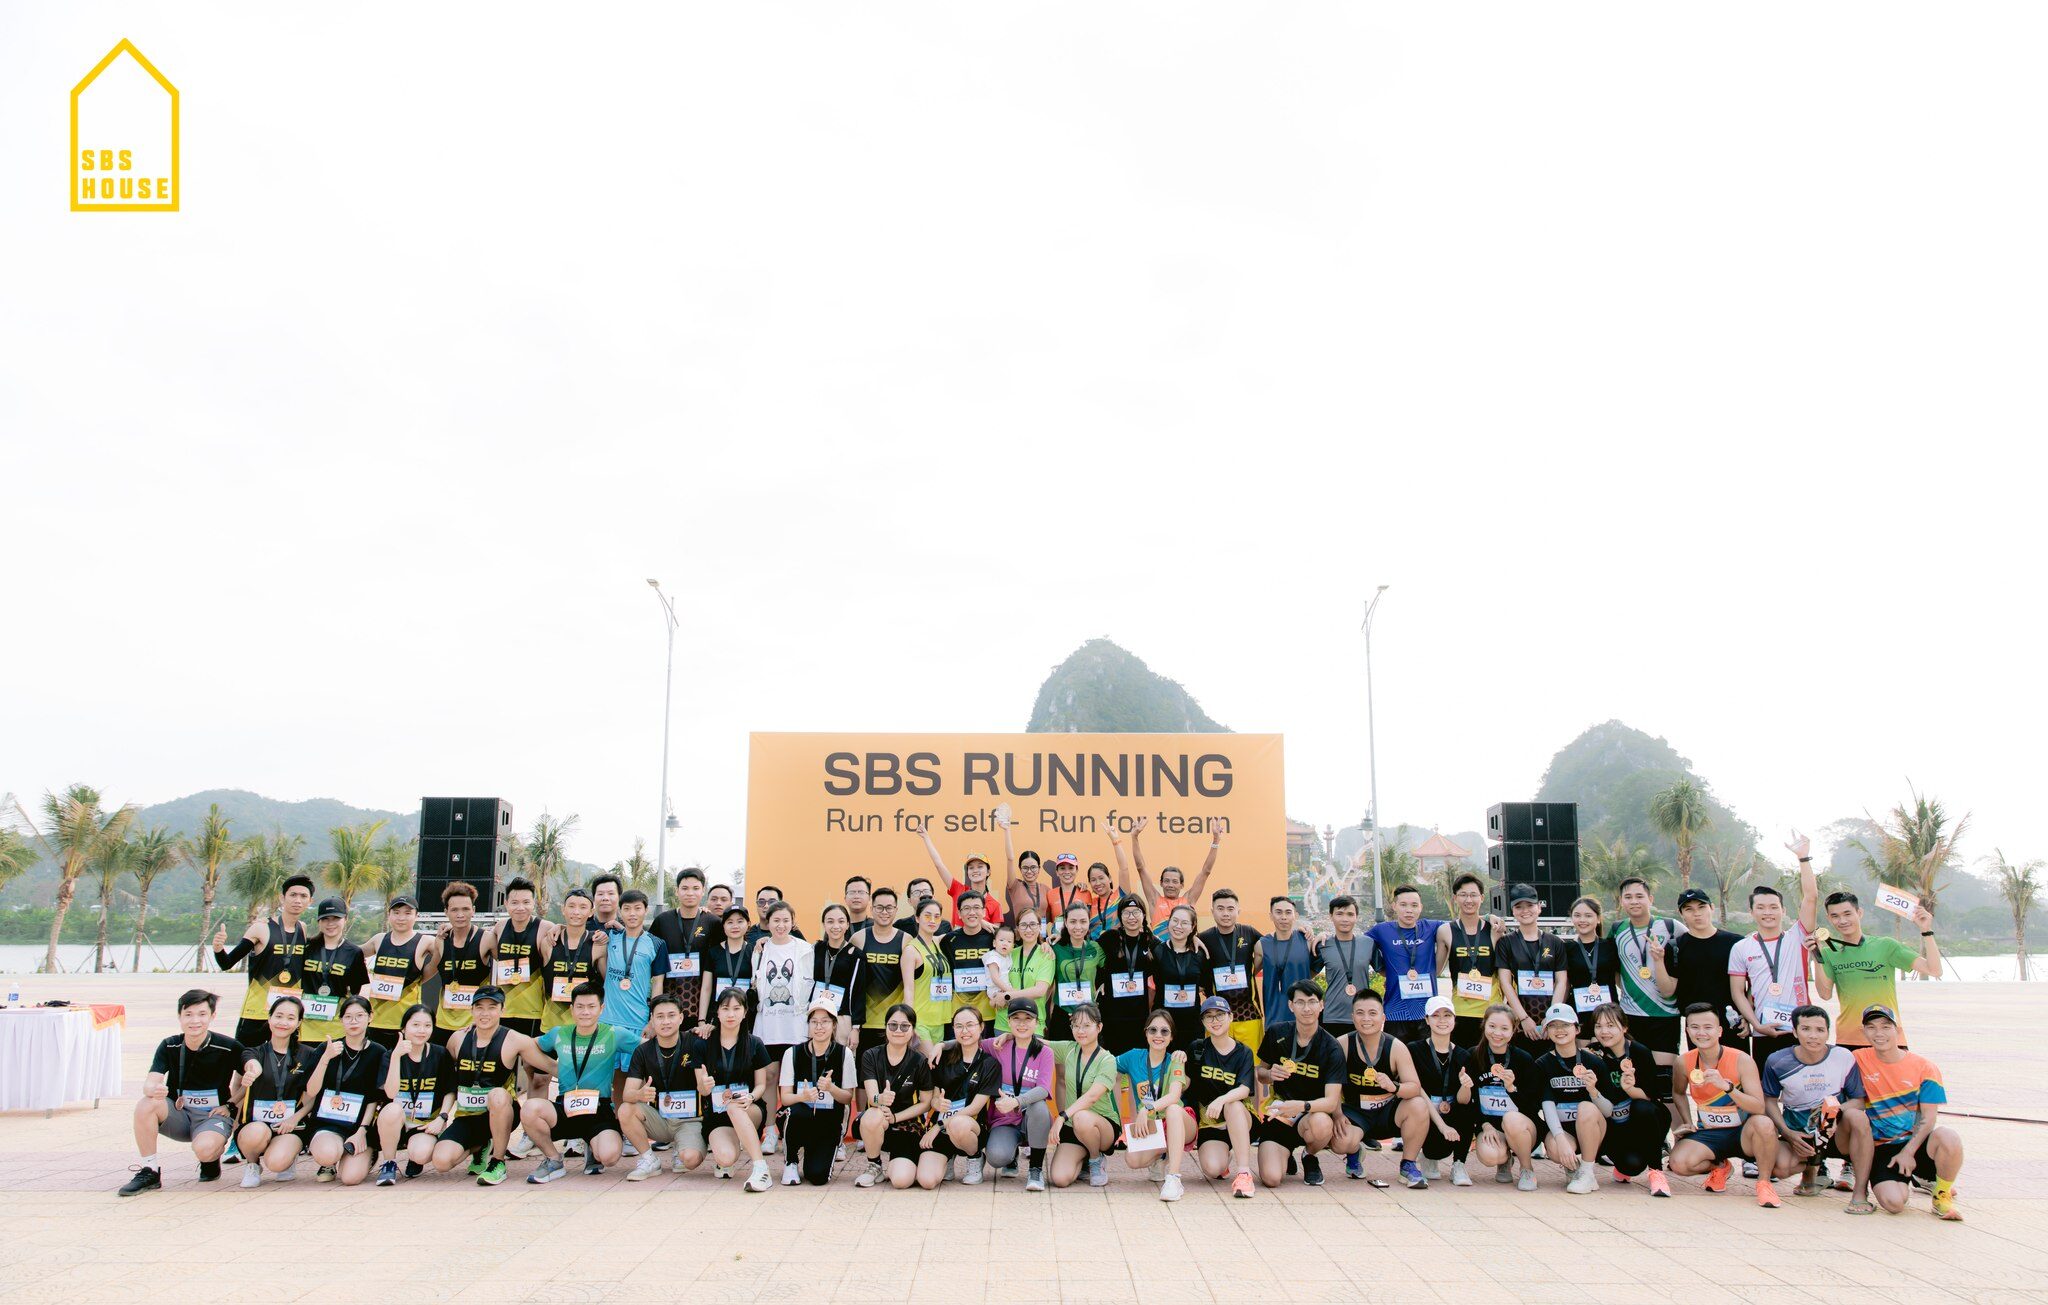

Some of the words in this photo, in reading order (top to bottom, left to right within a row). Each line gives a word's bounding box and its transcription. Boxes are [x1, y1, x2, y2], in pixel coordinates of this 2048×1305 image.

[824, 752, 942, 796] SBS
[963, 752, 1234, 798] RUNNING
[826, 808, 883, 832] Run
[894, 808, 935, 832] for
[944, 808, 998, 832] self
[1039, 808, 1096, 833] Run
[1156, 811, 1231, 834] team
[1885, 894, 1910, 910] 230
[955, 948, 990, 961] SBS
[1456, 946, 1490, 957] SS
[376, 956, 410, 969] SBS
[866, 952, 900, 965] SBS
[303, 959, 347, 976] SS
[1832, 960, 1875, 972] saucony
[961, 976, 979, 985] 734
[377, 983, 394, 993] 201
[1408, 982, 1424, 991] 741
[1465, 982, 1483, 992] 213
[451, 993, 471, 1002] 204
[1583, 995, 1603, 1004] 764
[311, 1003, 327, 1013] 101
[1200, 1065, 1237, 1087] SBS
[187, 1097, 209, 1105] 765
[466, 1096, 486, 1105] 106
[570, 1098, 590, 1109] 250
[670, 1101, 686, 1110] 731
[1489, 1098, 1507, 1108] 714
[1707, 1114, 1731, 1124] 303
